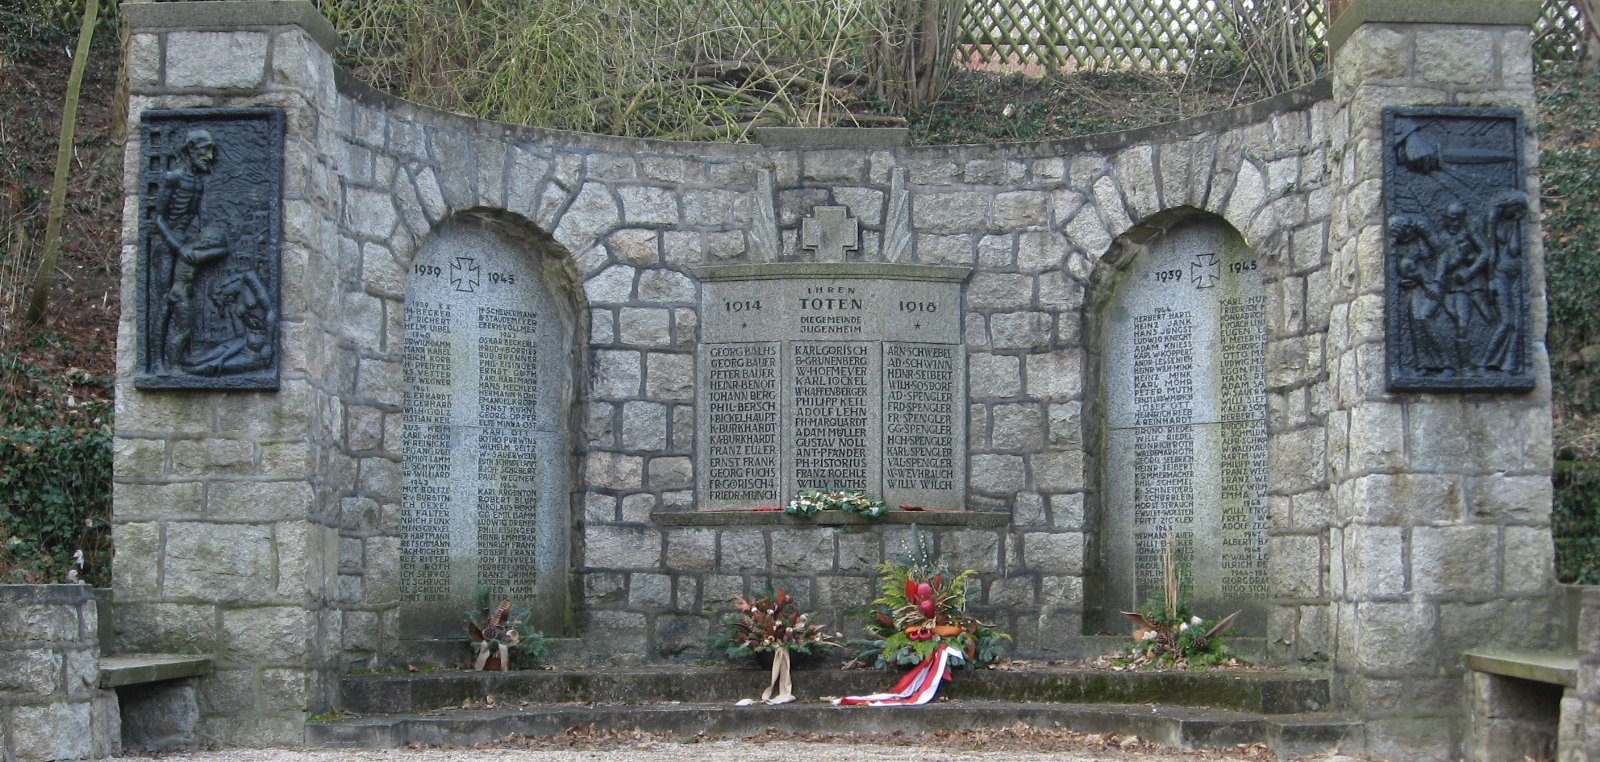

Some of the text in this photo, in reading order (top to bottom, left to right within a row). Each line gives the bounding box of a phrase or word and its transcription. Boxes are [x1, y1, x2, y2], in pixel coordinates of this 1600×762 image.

[415, 264, 515, 284] 1939 1945
[1156, 261, 1257, 282] 1939 1945
[725, 298, 937, 312] 1914 TOTEN 1918
[417, 316, 451, 325] RICHERT
[1221, 328, 1250, 337] EUGEN
[711, 347, 743, 357] GEORG
[796, 346, 822, 355] KARL
[1223, 351, 1247, 359] OTTO
[711, 358, 775, 367] GEORG BAUER
[711, 369, 774, 379] PETER BAUER
[796, 377, 826, 385] KARL
[1221, 382, 1249, 390] ADAM
[751, 391, 776, 399] BERG
[796, 398, 866, 406] PHILIPP KEIL
[479, 411, 506, 419] GEORG
[797, 408, 866, 416] ADOLF LEHN
[796, 428, 826, 437] ADAM
[796, 438, 867, 447] GUSTAV NOLL
[710, 445, 776, 455] FRANZ EULER
[887, 447, 953, 457] KARL SPENGLER
[710, 457, 775, 467] ERNST FRANK
[710, 468, 775, 477] GEORG FUCHS
[796, 469, 867, 478] FRANZ ROEHLE
[797, 480, 867, 488] WILLY RUTHS
[920, 481, 952, 490] WILCH
